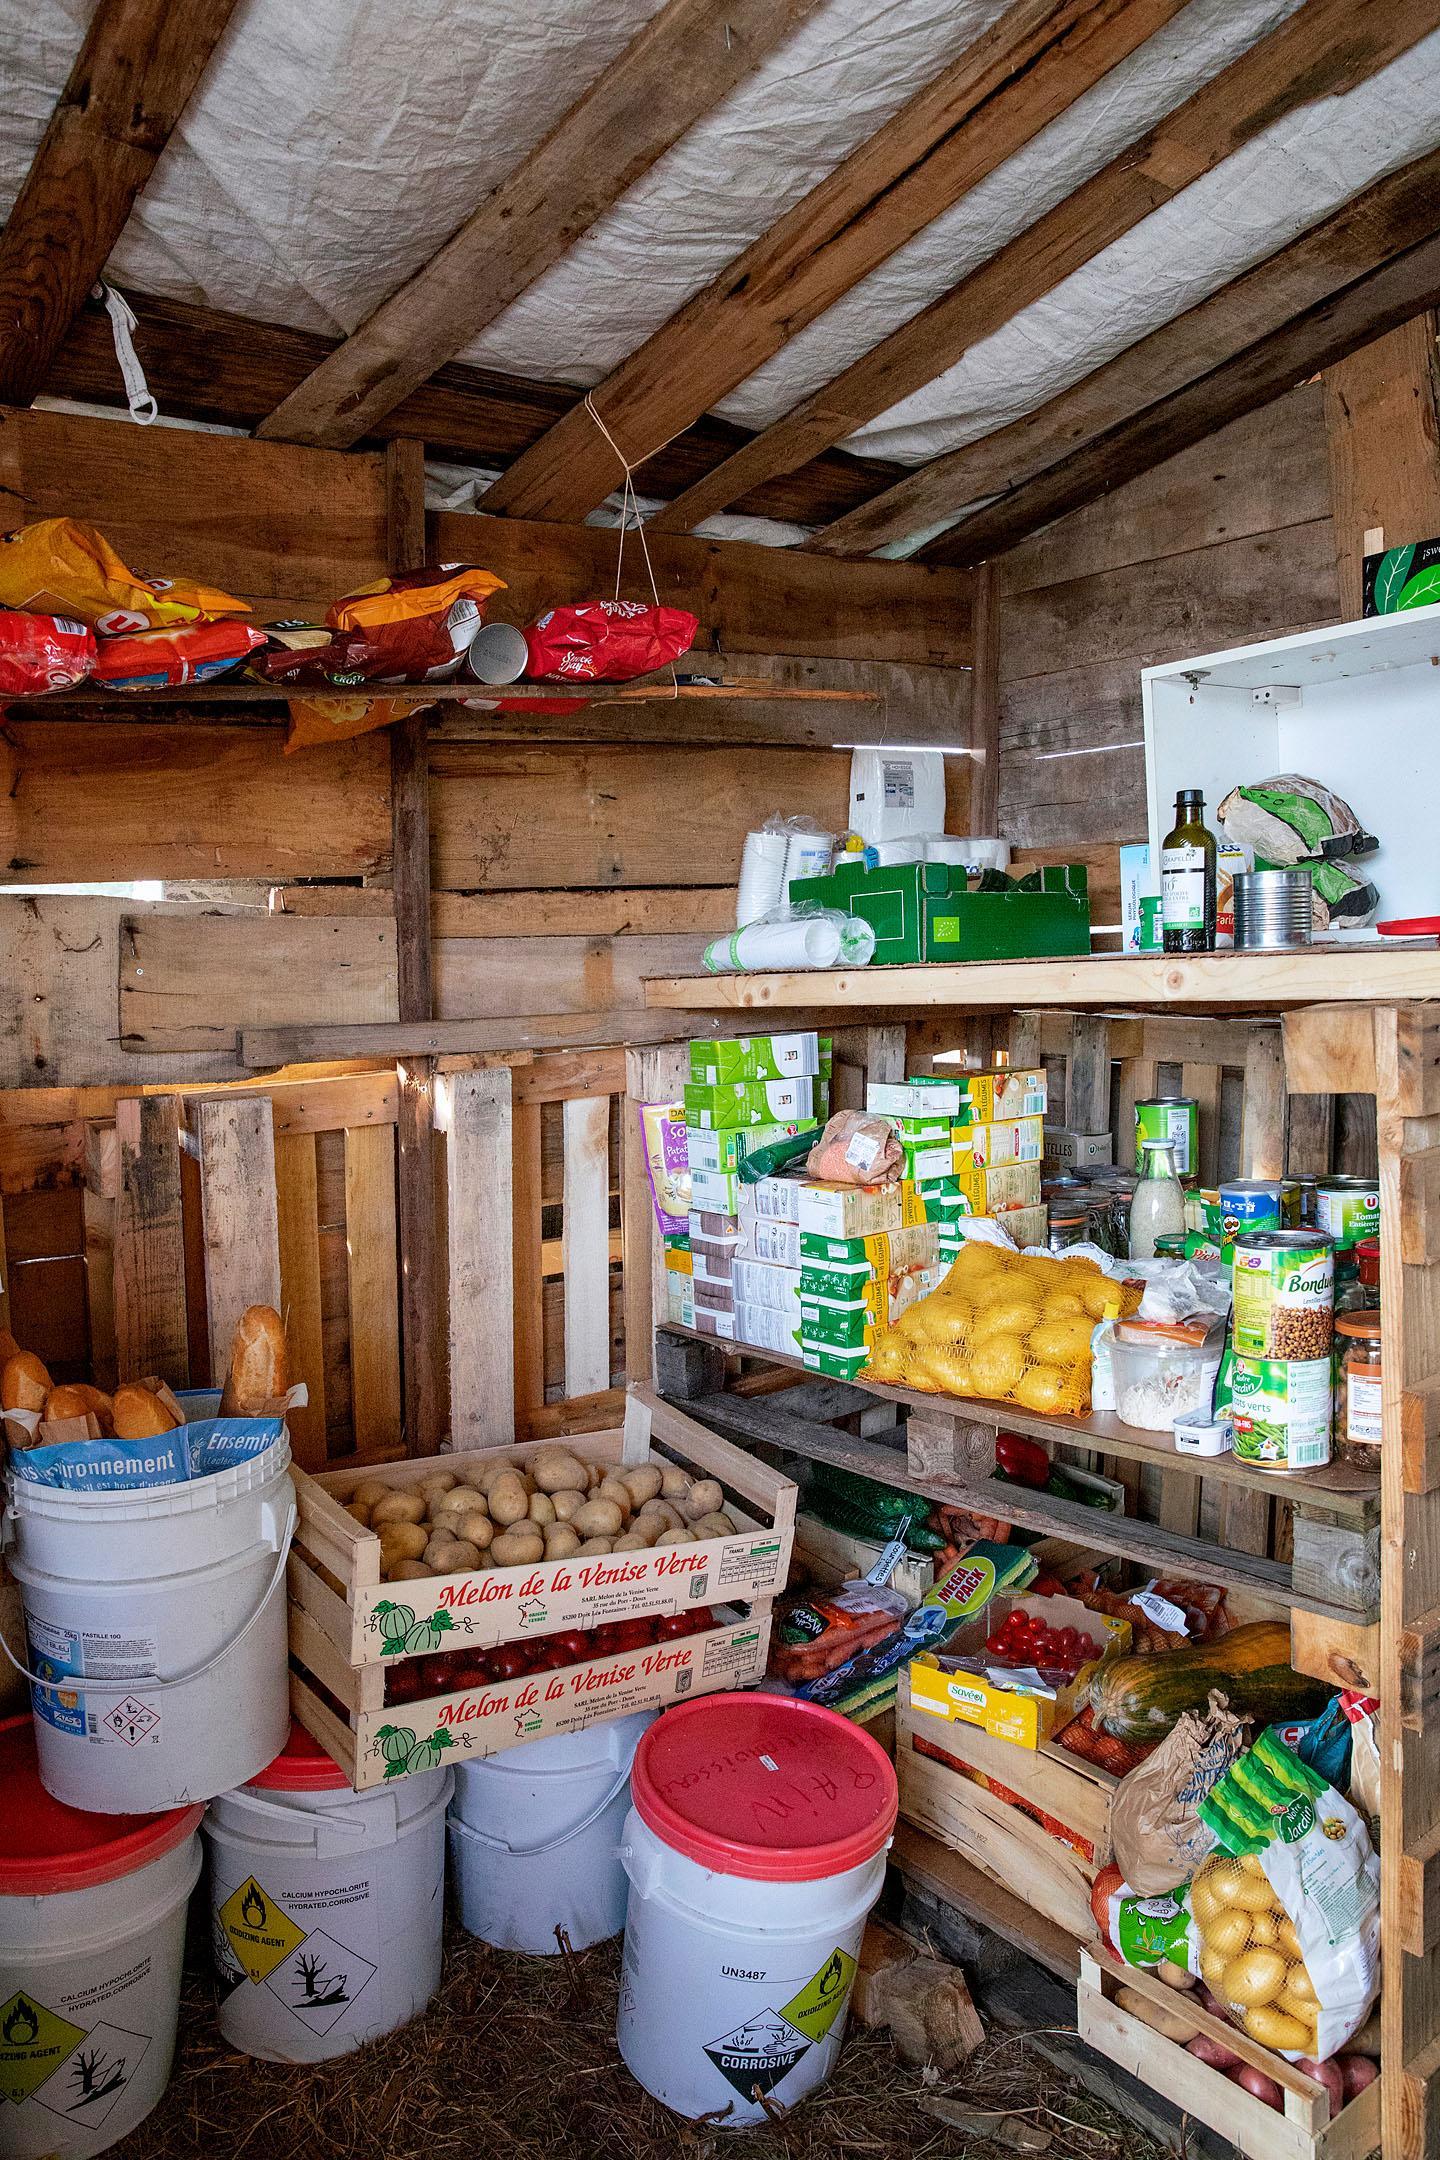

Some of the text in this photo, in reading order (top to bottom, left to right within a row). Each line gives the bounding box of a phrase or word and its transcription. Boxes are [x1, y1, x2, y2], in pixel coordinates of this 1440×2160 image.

[1247, 1402, 1271, 1413] verts
[437, 1577, 514, 1610] Melon
[518, 1571, 545, 1597] de
[551, 1567, 573, 1592] la
[578, 1561, 648, 1590] Venise
[654, 1551, 710, 1577] Verte
[936, 1565, 970, 1605] MEGA
[954, 1567, 988, 1606] PACK
[598, 1593, 615, 1601] Melon
[628, 1588, 645, 1596] Venise
[602, 1606, 627, 1615] Fontaines
[436, 1691, 510, 1729] Melon
[513, 1682, 540, 1709] de
[545, 1676, 565, 1700] la
[570, 1663, 639, 1696] Venise
[641, 1649, 693, 1676] Verte
[589, 1696, 605, 1704] Melon
[1286, 1804, 1302, 1823] Notre
[1287, 1806, 1313, 1843] Jardin
[281, 1881, 370, 1899] CALCIUM HYPOCHLORITE
[229, 1925, 286, 1948] OXIDIZING AGENT
[60, 1956, 152, 2003] CALCIUM HYPOCHLORITE
[721, 1965, 767, 1981] UN3487
[798, 1997, 832, 2019] OXIDIZING
[30, 2046, 62, 2060] AGENT
[720, 2053, 796, 2070] CORROSIVE
